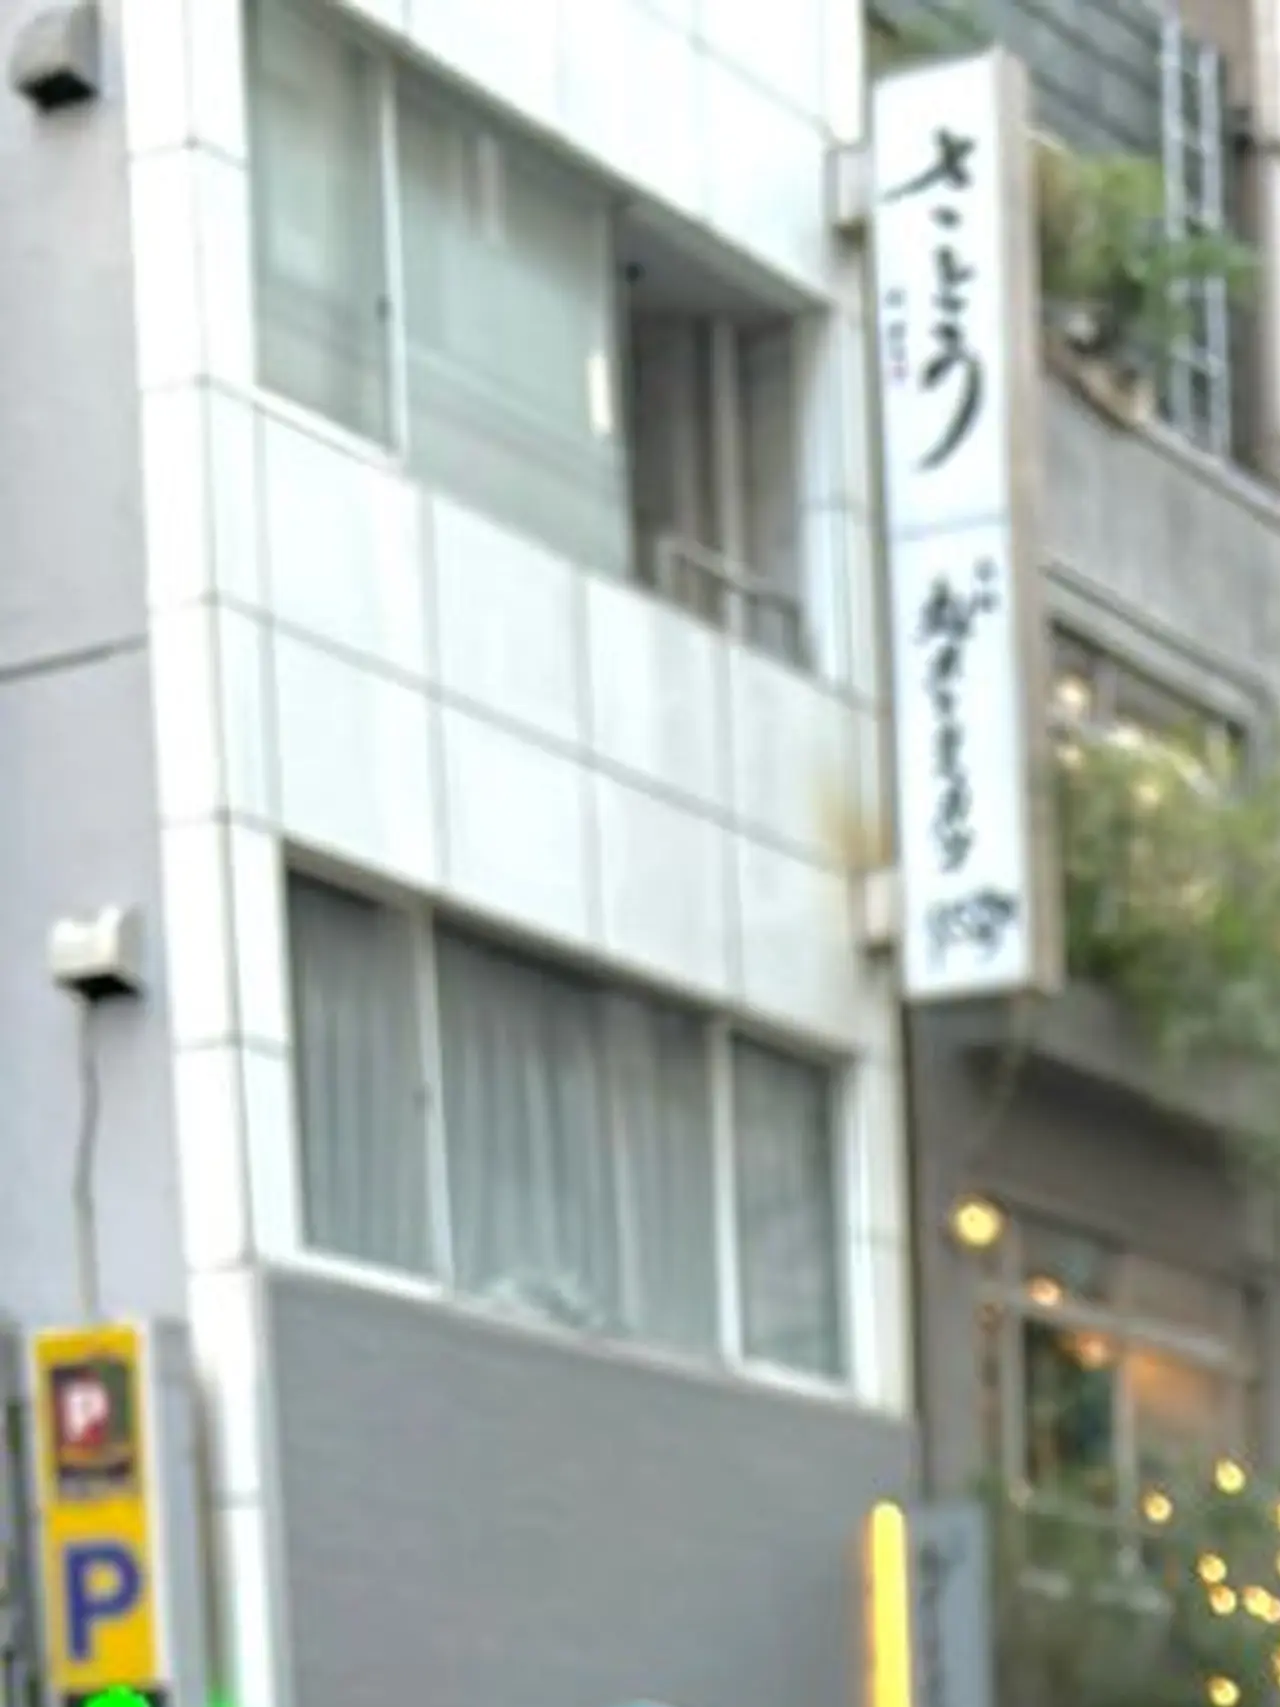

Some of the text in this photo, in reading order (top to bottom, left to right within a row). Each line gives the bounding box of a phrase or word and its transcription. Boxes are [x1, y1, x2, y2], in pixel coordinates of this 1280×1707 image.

[879, 126, 982, 471] さとう
[64, 1540, 143, 1665] P
